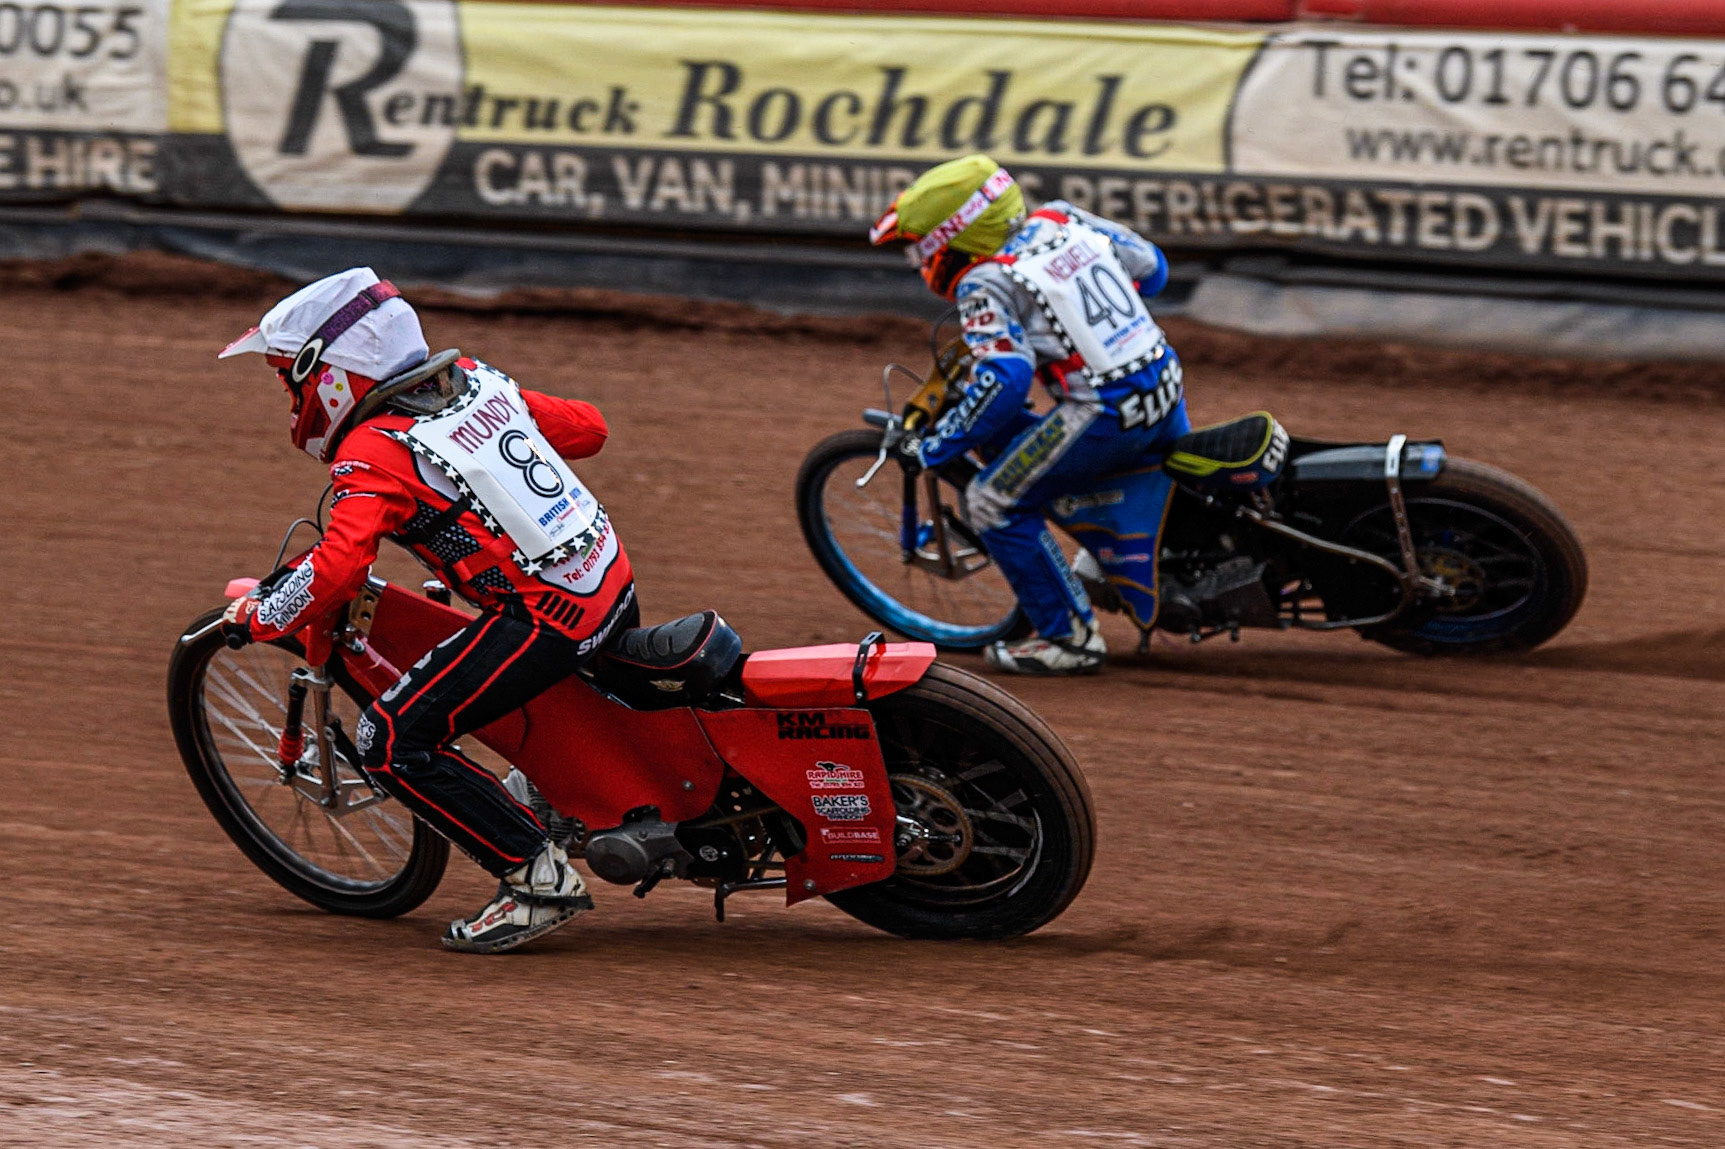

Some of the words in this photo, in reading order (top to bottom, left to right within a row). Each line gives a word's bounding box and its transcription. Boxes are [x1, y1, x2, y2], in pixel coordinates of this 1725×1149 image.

[1301, 40, 1417, 102] Tel:
[1435, 46, 1643, 113] 01706
[663, 57, 1177, 160] Rochdale
[27, 136, 157, 194] HIRE
[474, 148, 606, 218] CAR,
[612, 155, 753, 225] VAN,
[1060, 174, 1499, 251] REFRIGERATED
[1042, 240, 1101, 284] NEWELL
[1074, 264, 1137, 330] 40
[449, 390, 519, 454] MUNDY
[498, 429, 566, 499] 8
[538, 497, 570, 527] BRITISH
[563, 567, 584, 584] Tel:
[777, 713, 825, 726] KM
[778, 726, 870, 740] RACING
[808, 771, 837, 779] RAPID
[838, 771, 863, 779] HIRE
[813, 796, 869, 807] BAKER'S
[828, 831, 878, 840] BUILDBASE
